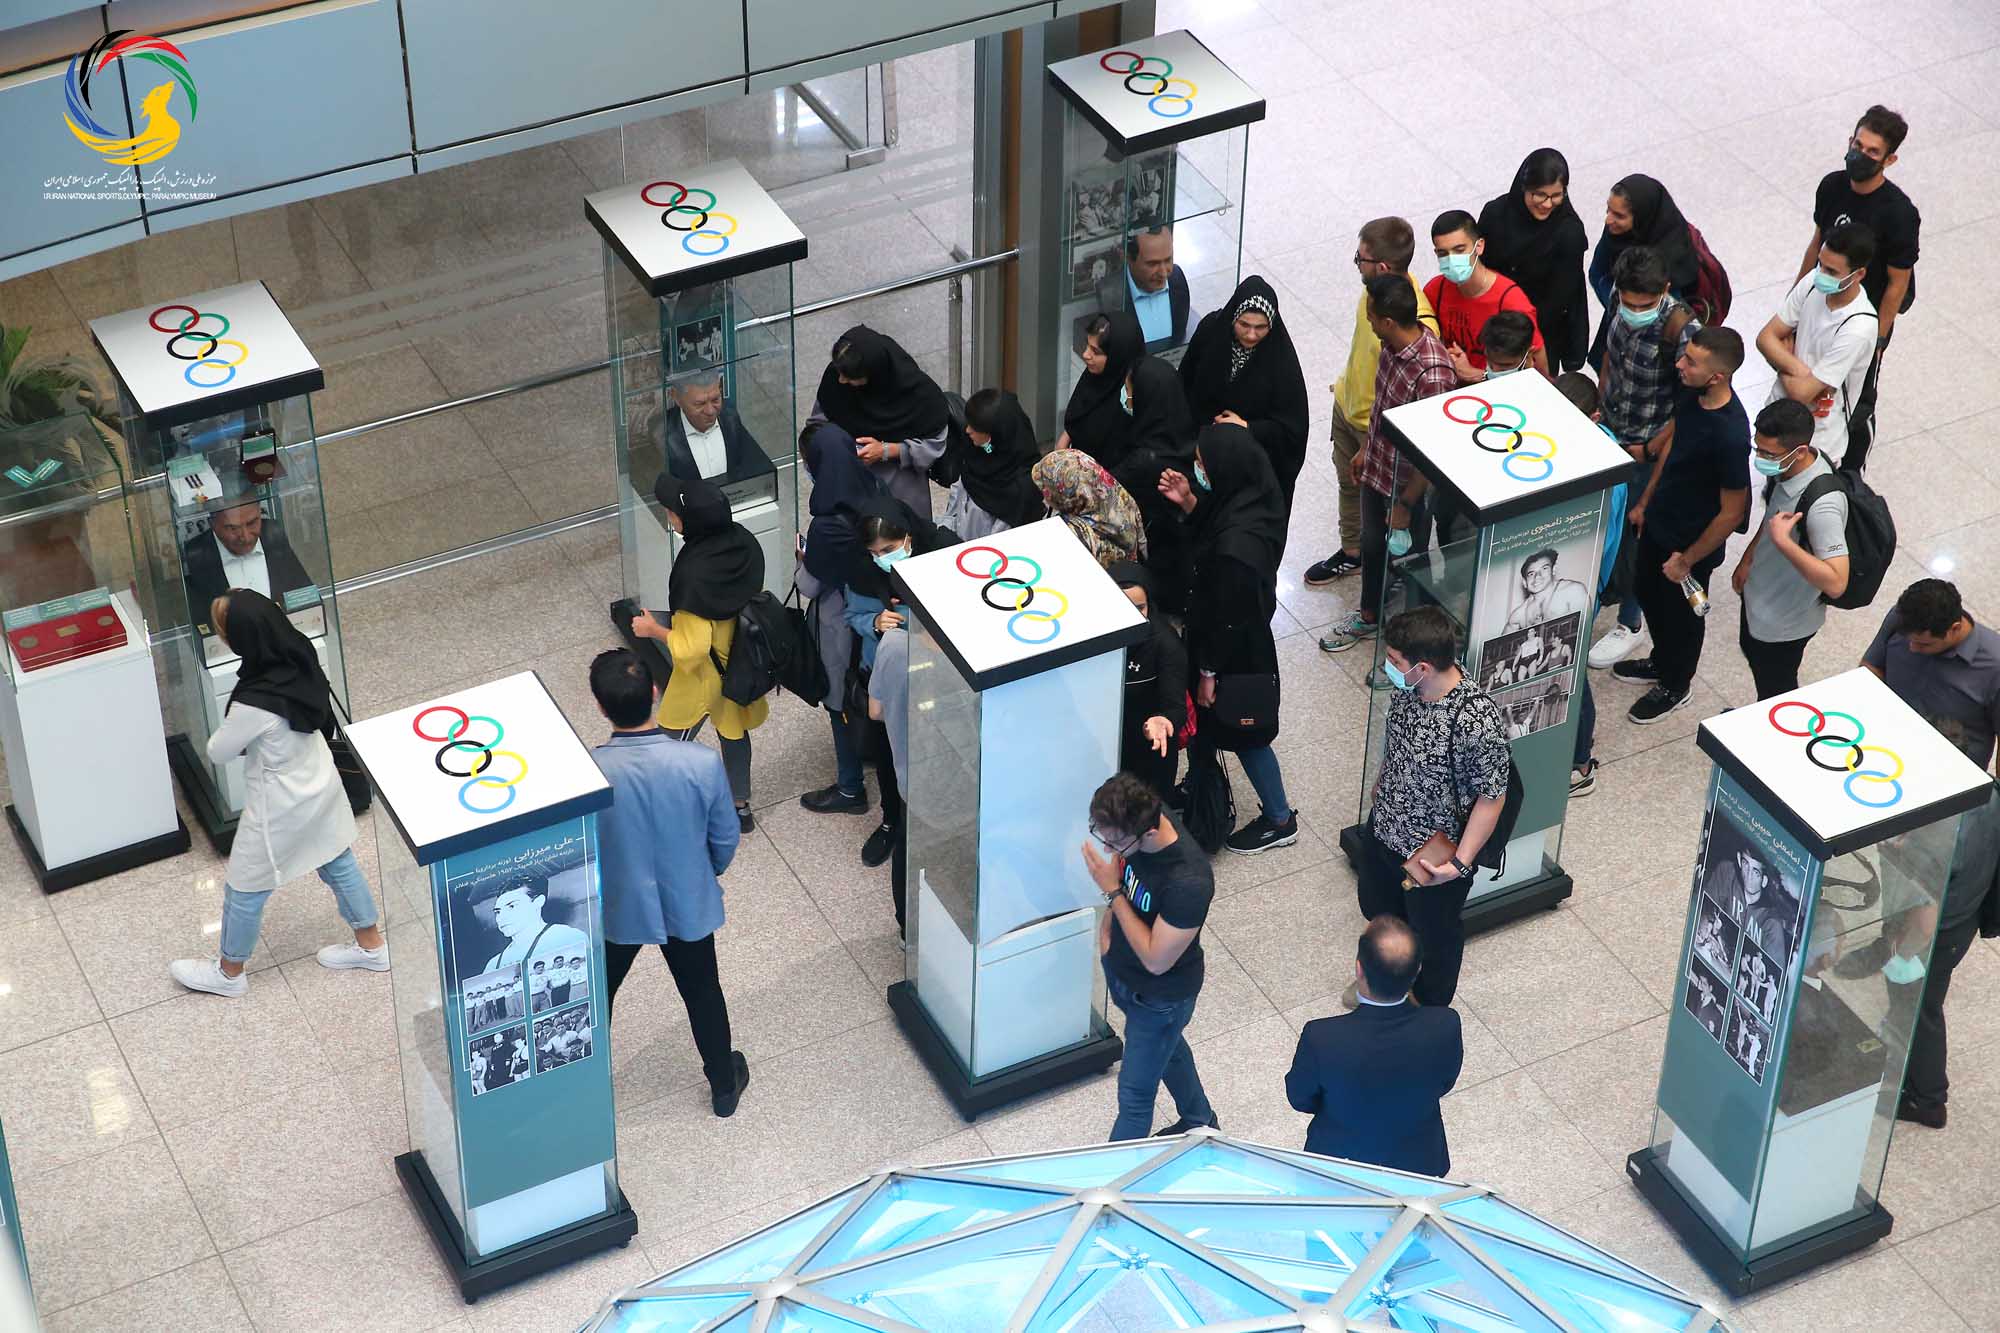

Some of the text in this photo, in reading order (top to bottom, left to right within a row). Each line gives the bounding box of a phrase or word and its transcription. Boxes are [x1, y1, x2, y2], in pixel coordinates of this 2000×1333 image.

[1564, 510, 1592, 525] محمود
[554, 836, 574, 850] علی
[514, 845, 551, 863] میرزایی
